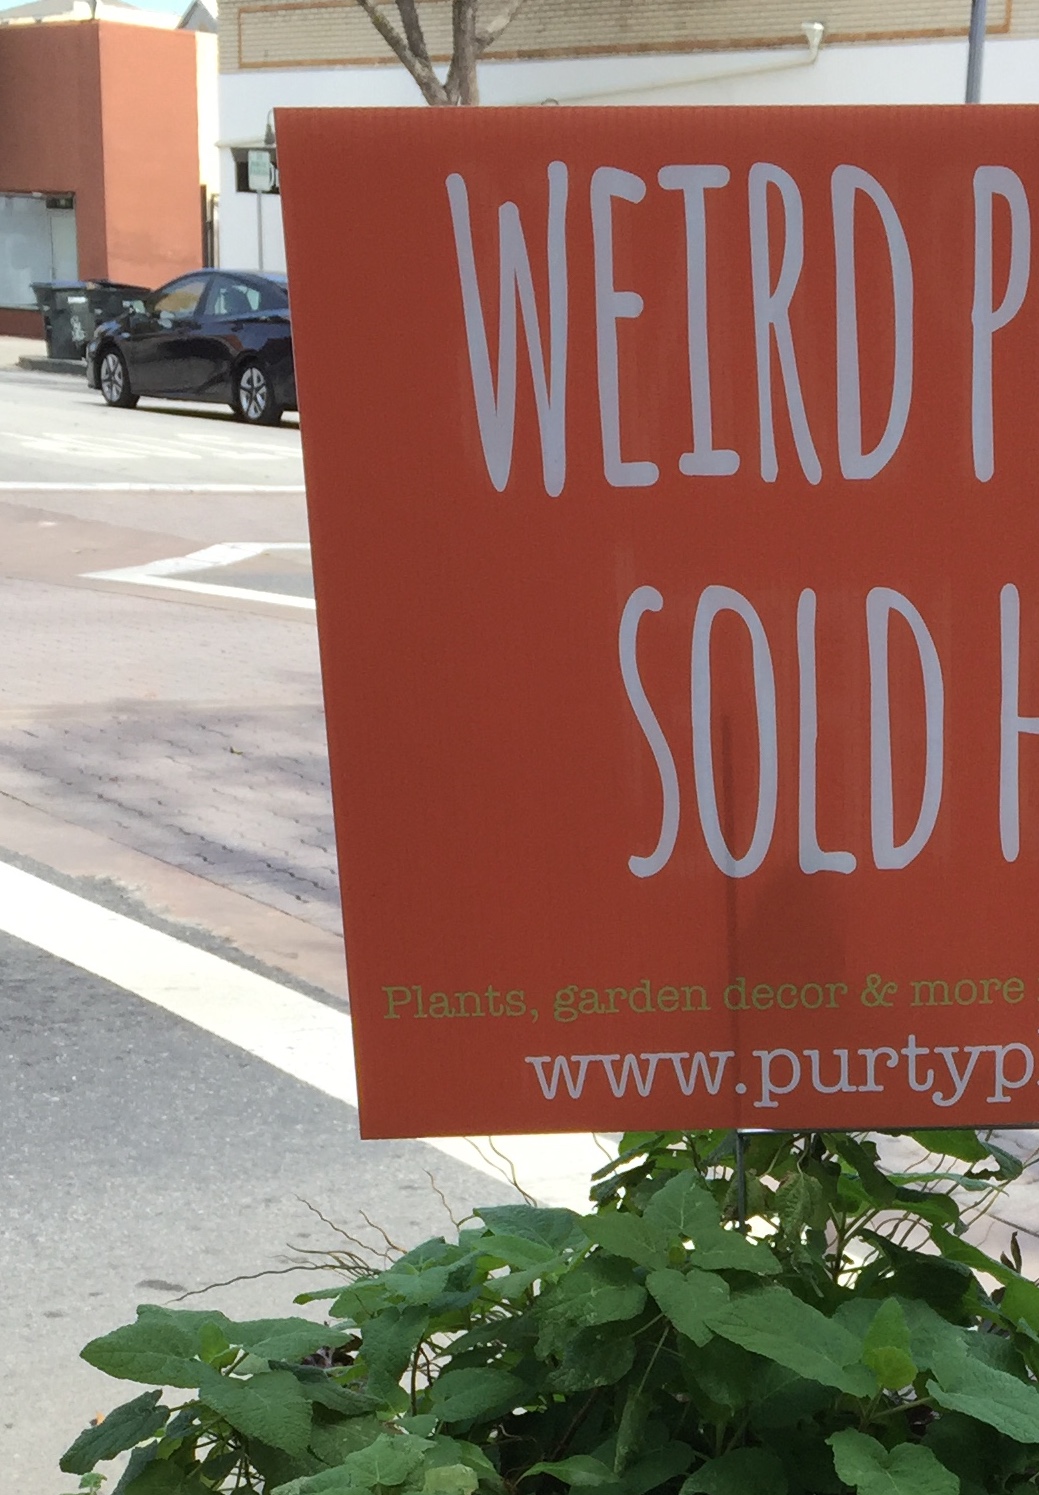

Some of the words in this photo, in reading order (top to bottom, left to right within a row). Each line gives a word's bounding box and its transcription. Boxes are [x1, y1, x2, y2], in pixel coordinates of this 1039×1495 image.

[445, 160, 914, 498] WEIRD
[618, 584, 945, 879] SOLD
[382, 983, 540, 1023] Plants,
[553, 978, 712, 1023] garden
[722, 975, 848, 1010] decor
[859, 972, 898, 1009] &
[909, 973, 1026, 1007] more
